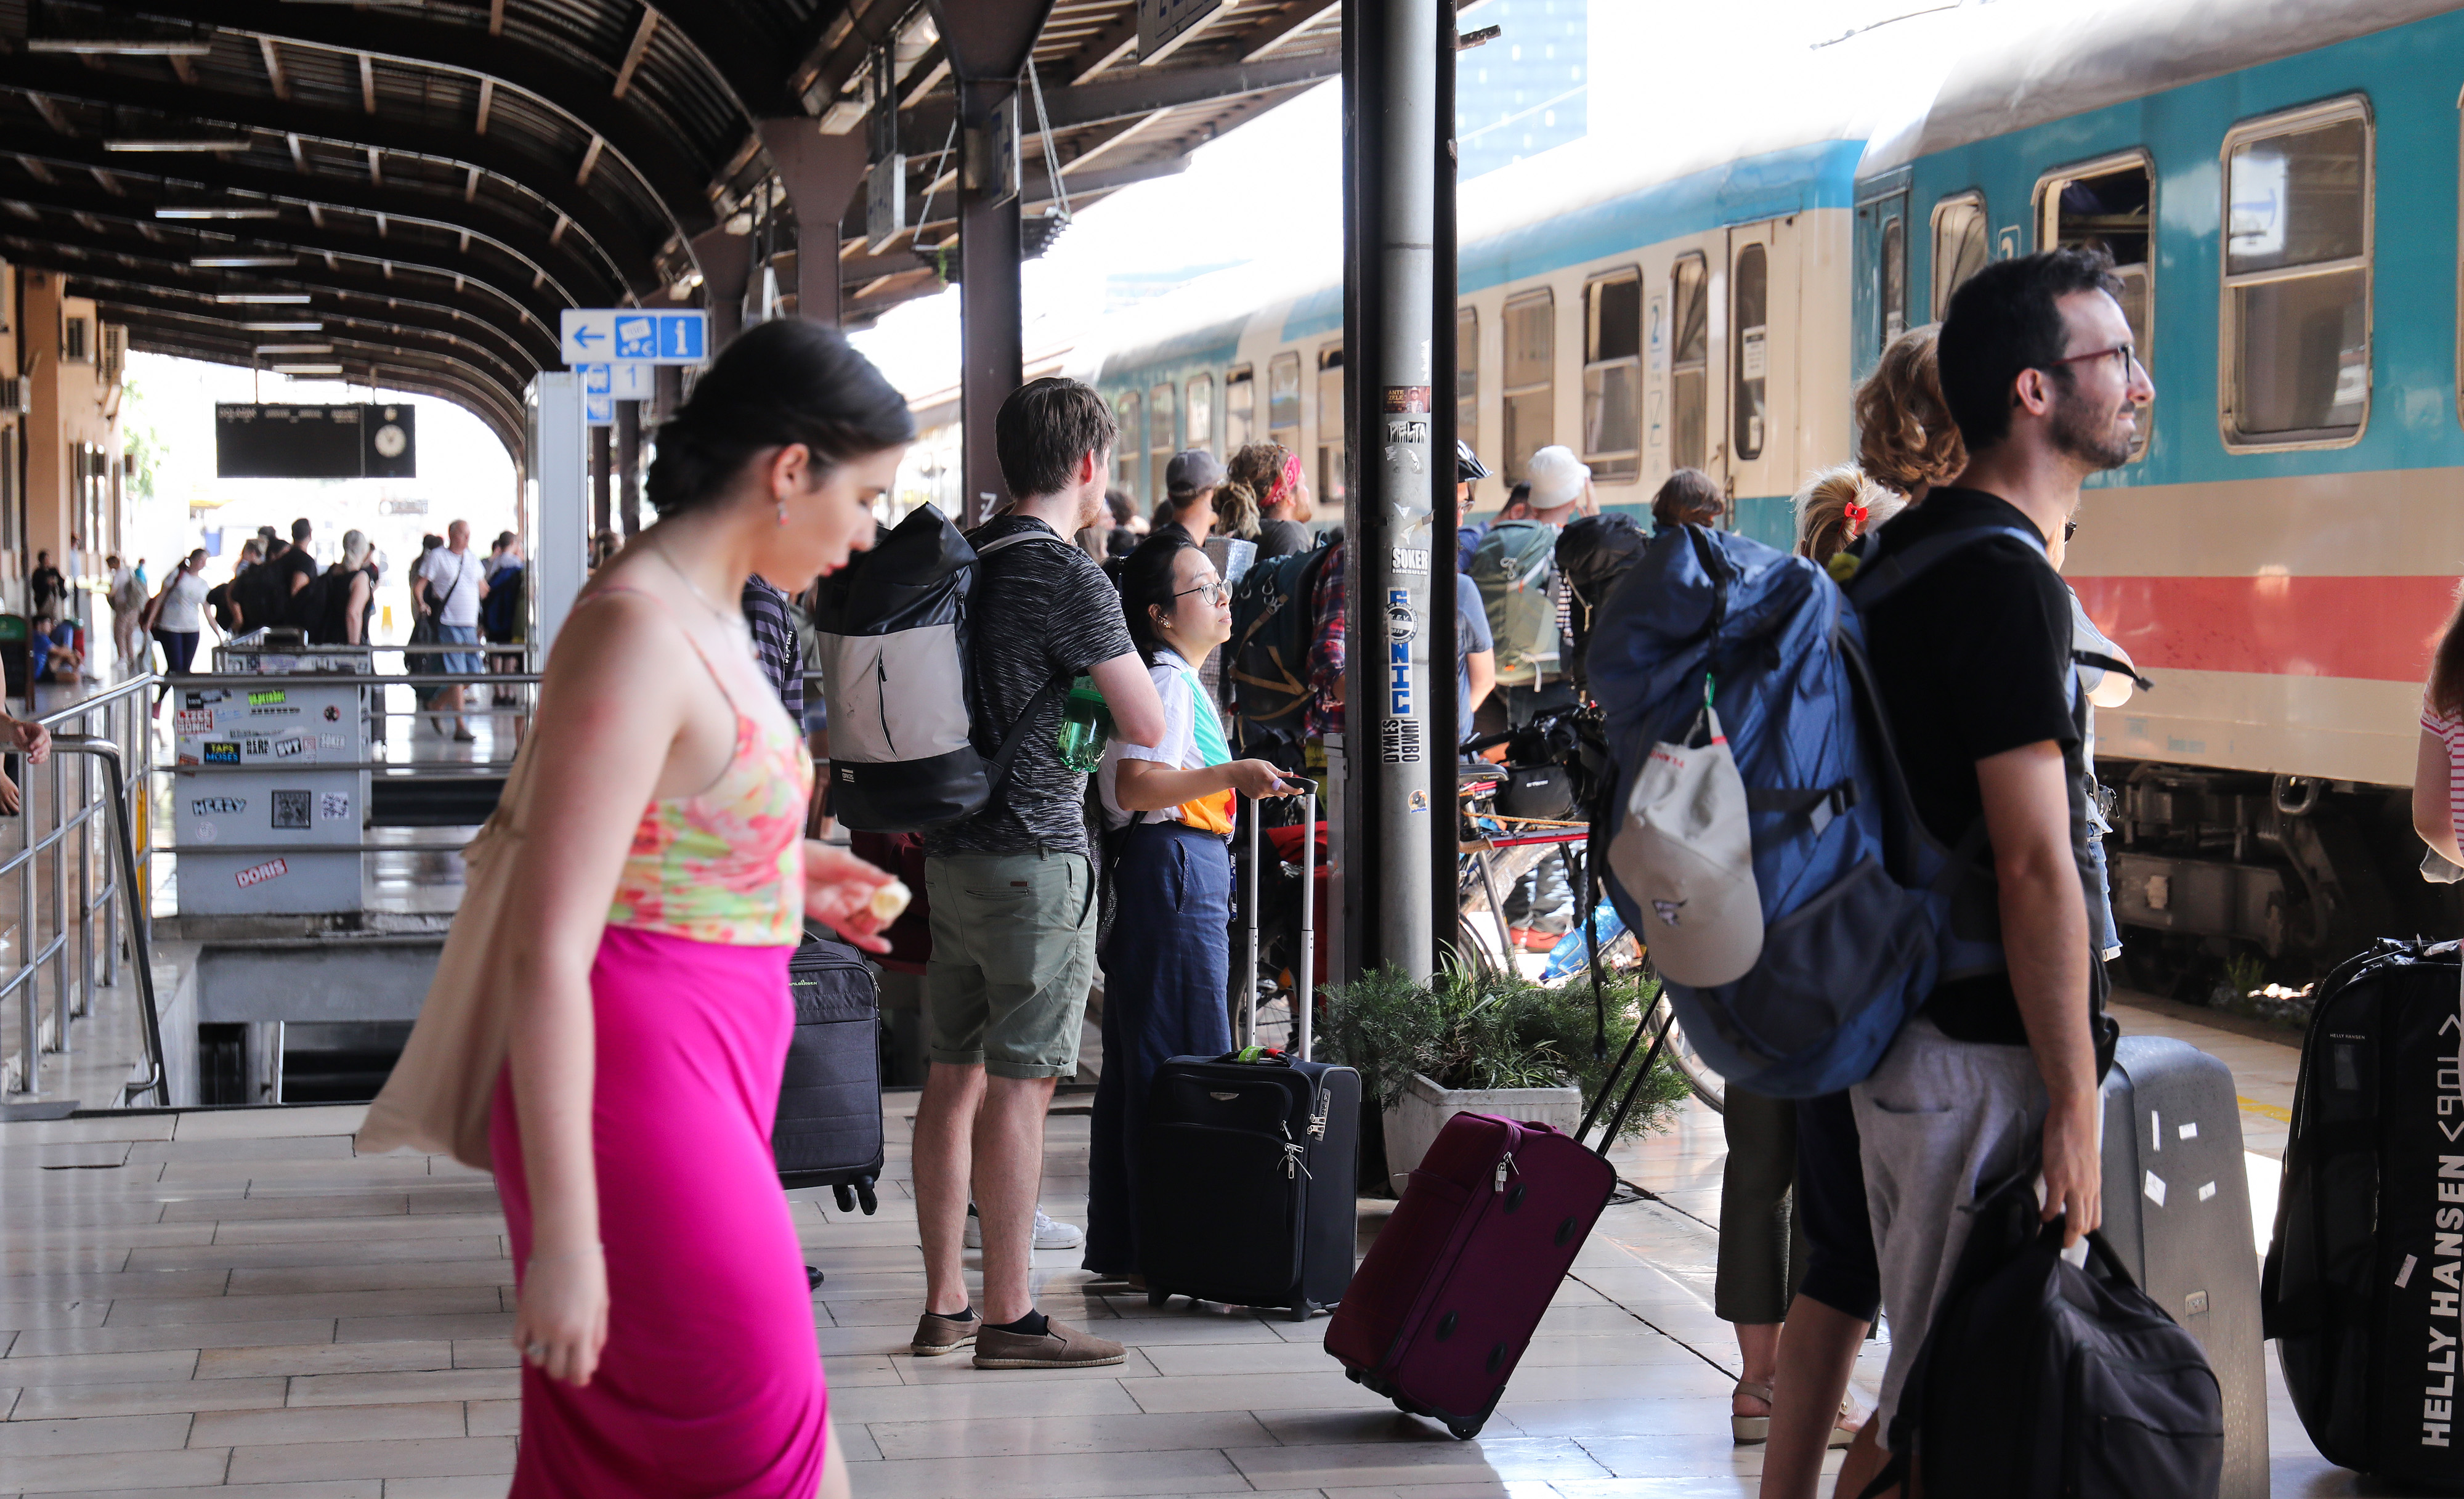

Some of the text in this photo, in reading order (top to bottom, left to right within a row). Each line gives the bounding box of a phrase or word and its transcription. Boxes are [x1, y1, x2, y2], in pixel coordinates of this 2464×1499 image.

[1392, 548, 1428, 570] SOKER
[1382, 720, 1399, 763] DYMES
[1401, 720, 1420, 762] JUMBO
[237, 859, 286, 887] DORIS
[2421, 1155, 2464, 1447] HELLY HANSEN
